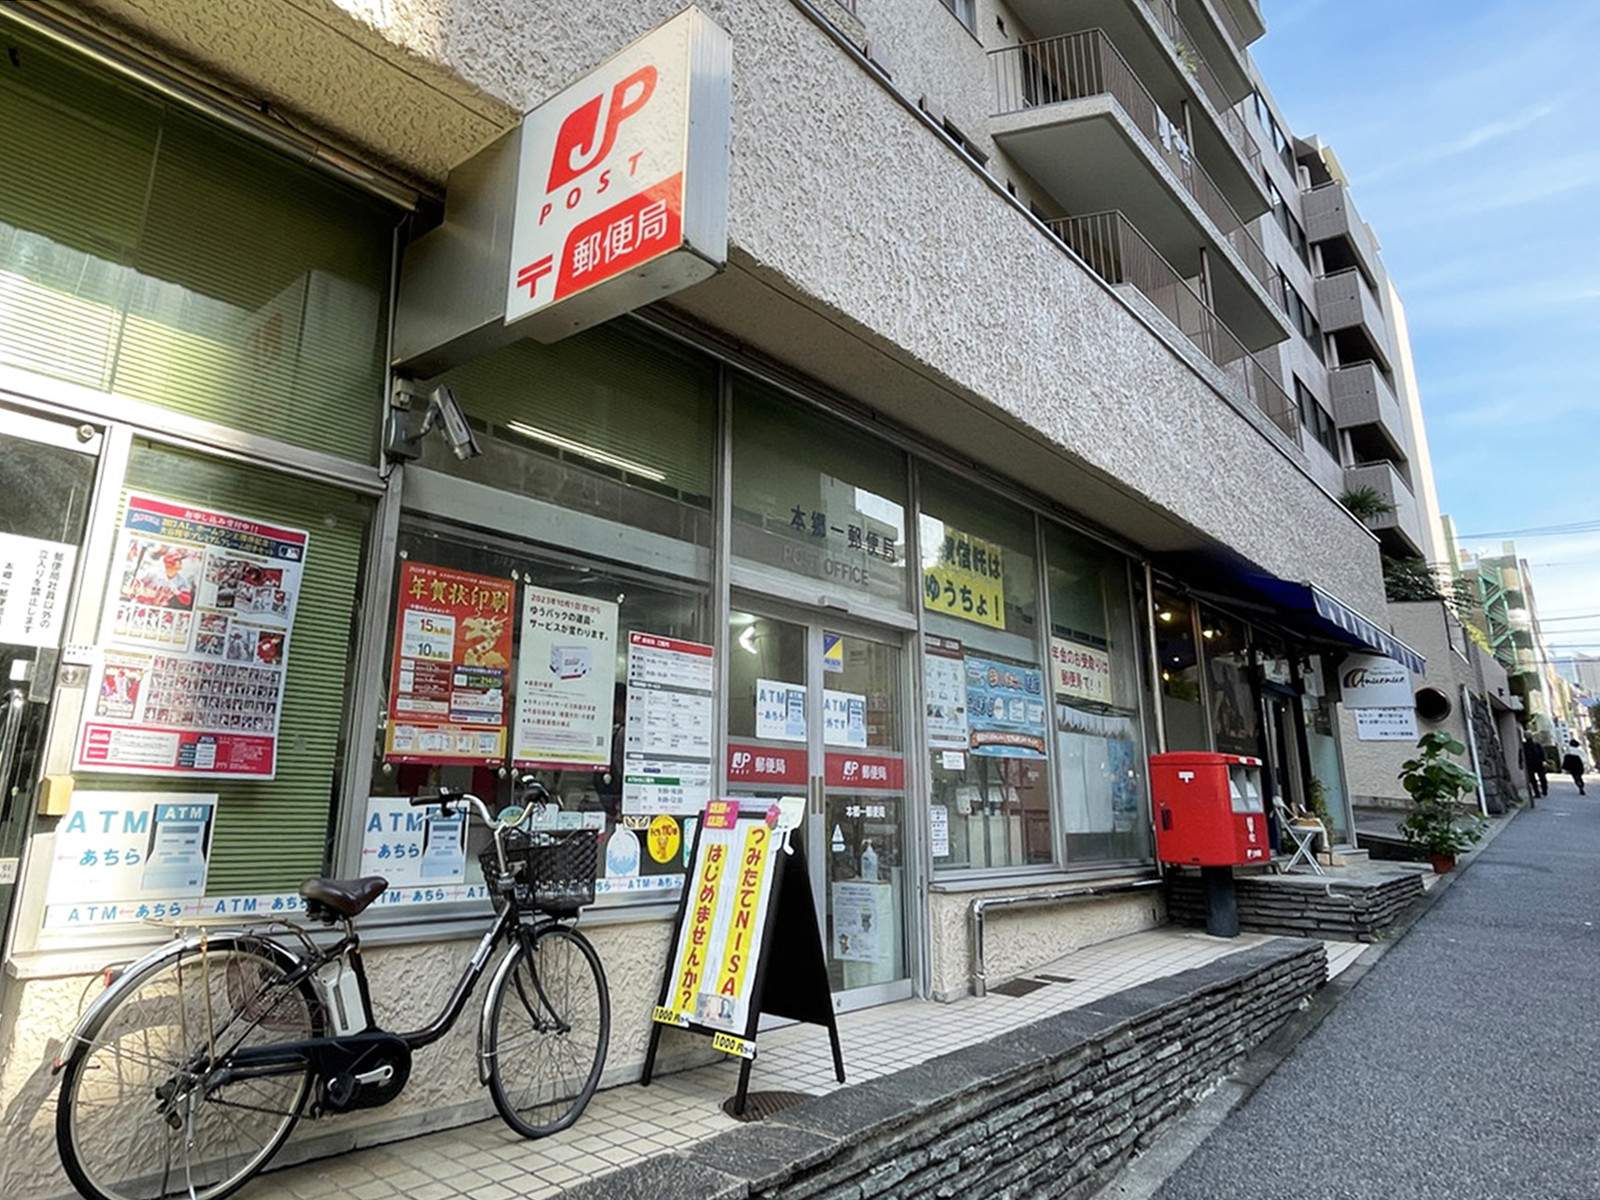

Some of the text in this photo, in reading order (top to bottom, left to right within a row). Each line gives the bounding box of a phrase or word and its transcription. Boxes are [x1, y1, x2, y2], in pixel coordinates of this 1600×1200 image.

[546, 65, 658, 194] JP
[539, 151, 644, 225] POST
[572, 199, 667, 277] 郵便局
[781, 545, 869, 586] POST OFFICE
[408, 575, 510, 614] 年賀状印刷
[759, 689, 785, 704] ATM
[823, 699, 846, 713] ATM
[765, 710, 785, 721] あちら
[754, 756, 786, 774] 郵便局
[861, 765, 887, 780] 郵便局
[66, 810, 148, 834] ATM
[164, 806, 203, 820] ATM
[367, 812, 423, 833] ATM
[79, 848, 141, 867] あちら
[377, 843, 420, 859] あちら
[628, 876, 683, 890] ATM あちら
[412, 889, 444, 902] あちら
[68, 902, 181, 922] ATM あちら
[215, 898, 257, 913] ATM
[722, 828, 766, 996] つみたてNISA
[681, 844, 722, 1009] はじめませんか?
